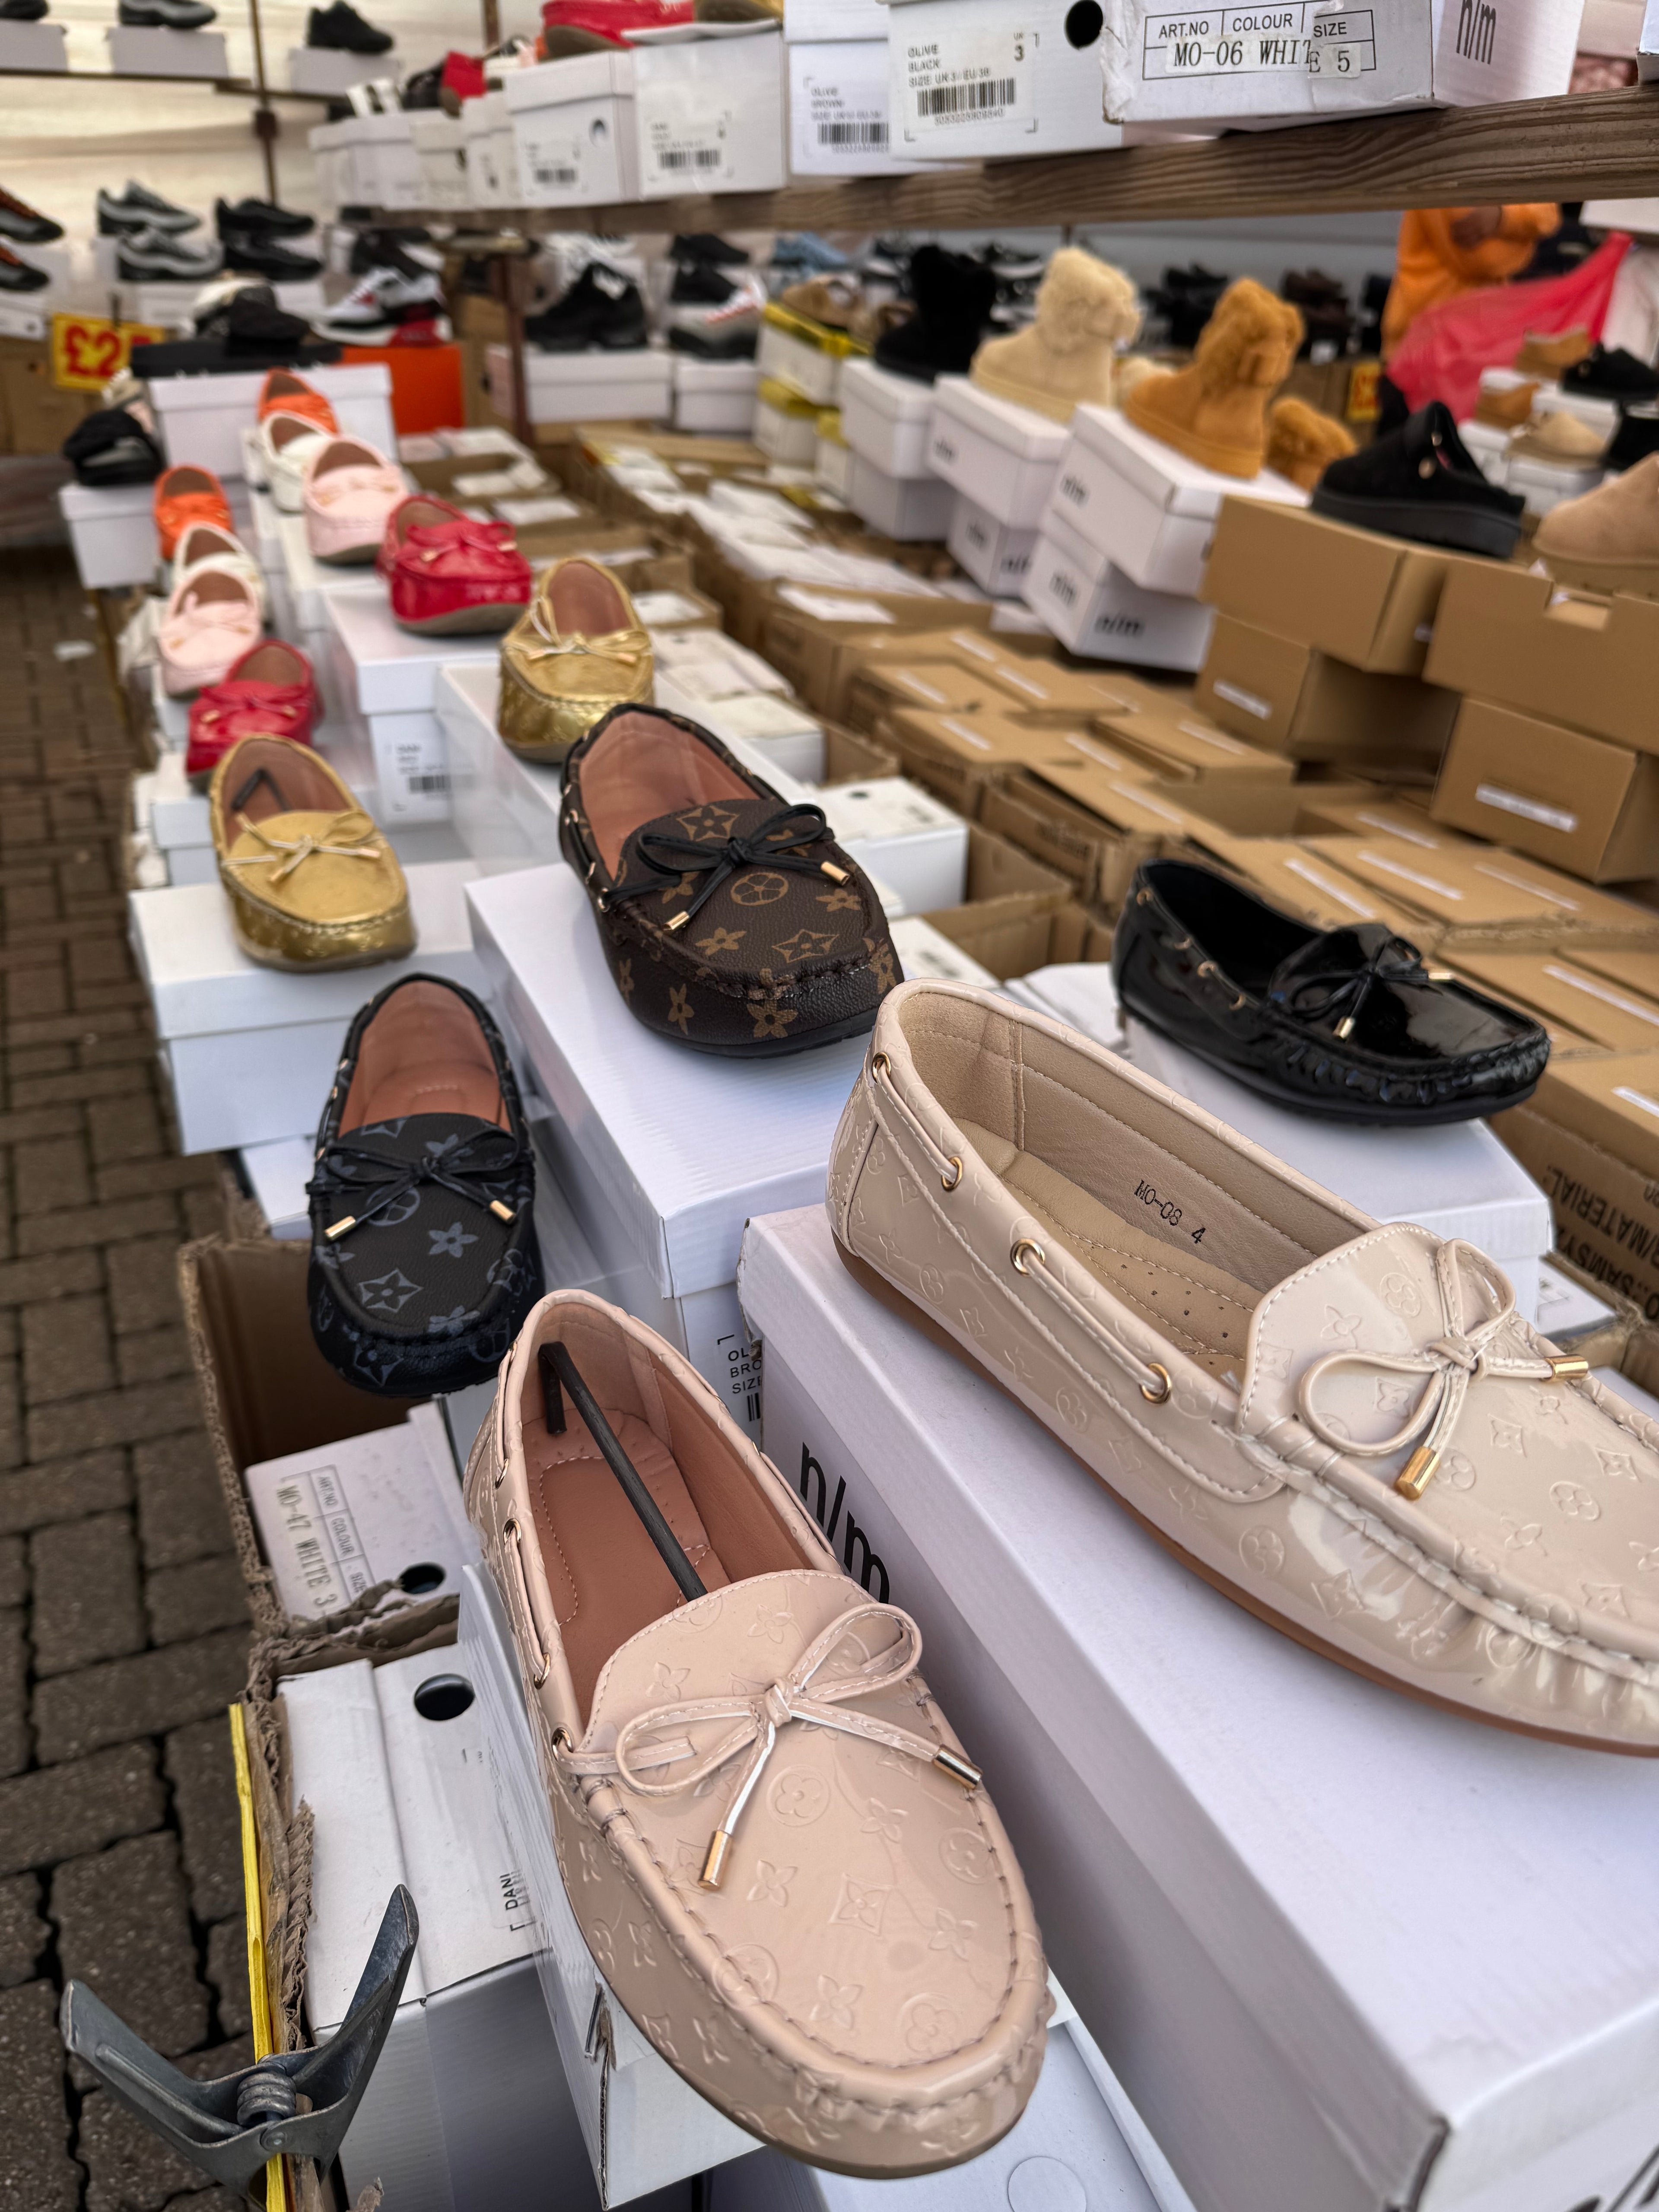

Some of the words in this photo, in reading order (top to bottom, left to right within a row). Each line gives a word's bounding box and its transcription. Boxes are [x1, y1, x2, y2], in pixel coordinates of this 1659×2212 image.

[1159, 21, 1208, 38] ART.NO
[1233, 13, 1293, 32] COLOUR
[1314, 22, 1347, 37] SIZE
[908, 44, 939, 58] OLIVE
[908, 58, 940, 73] BLACK
[1014, 44, 1025, 61] 3
[1173, 41, 1243, 67] MO-06
[1259, 39, 1320, 73] WHITE
[1338, 51, 1350, 73] 5
[1134, 1179, 1182, 1226] MO-08
[1191, 1227, 1206, 1244] 4
[728, 1348, 749, 1361] OL
[730, 1360, 762, 1378] BRO
[331, 1517, 355, 1556] COLOUR
[800, 1441, 890, 1604] n/m
[276, 1484, 312, 1531] MO-47
[295, 1537, 331, 1588] WHITE
[313, 1593, 338, 1606] 3
[499, 1873, 519, 1910] DANI
